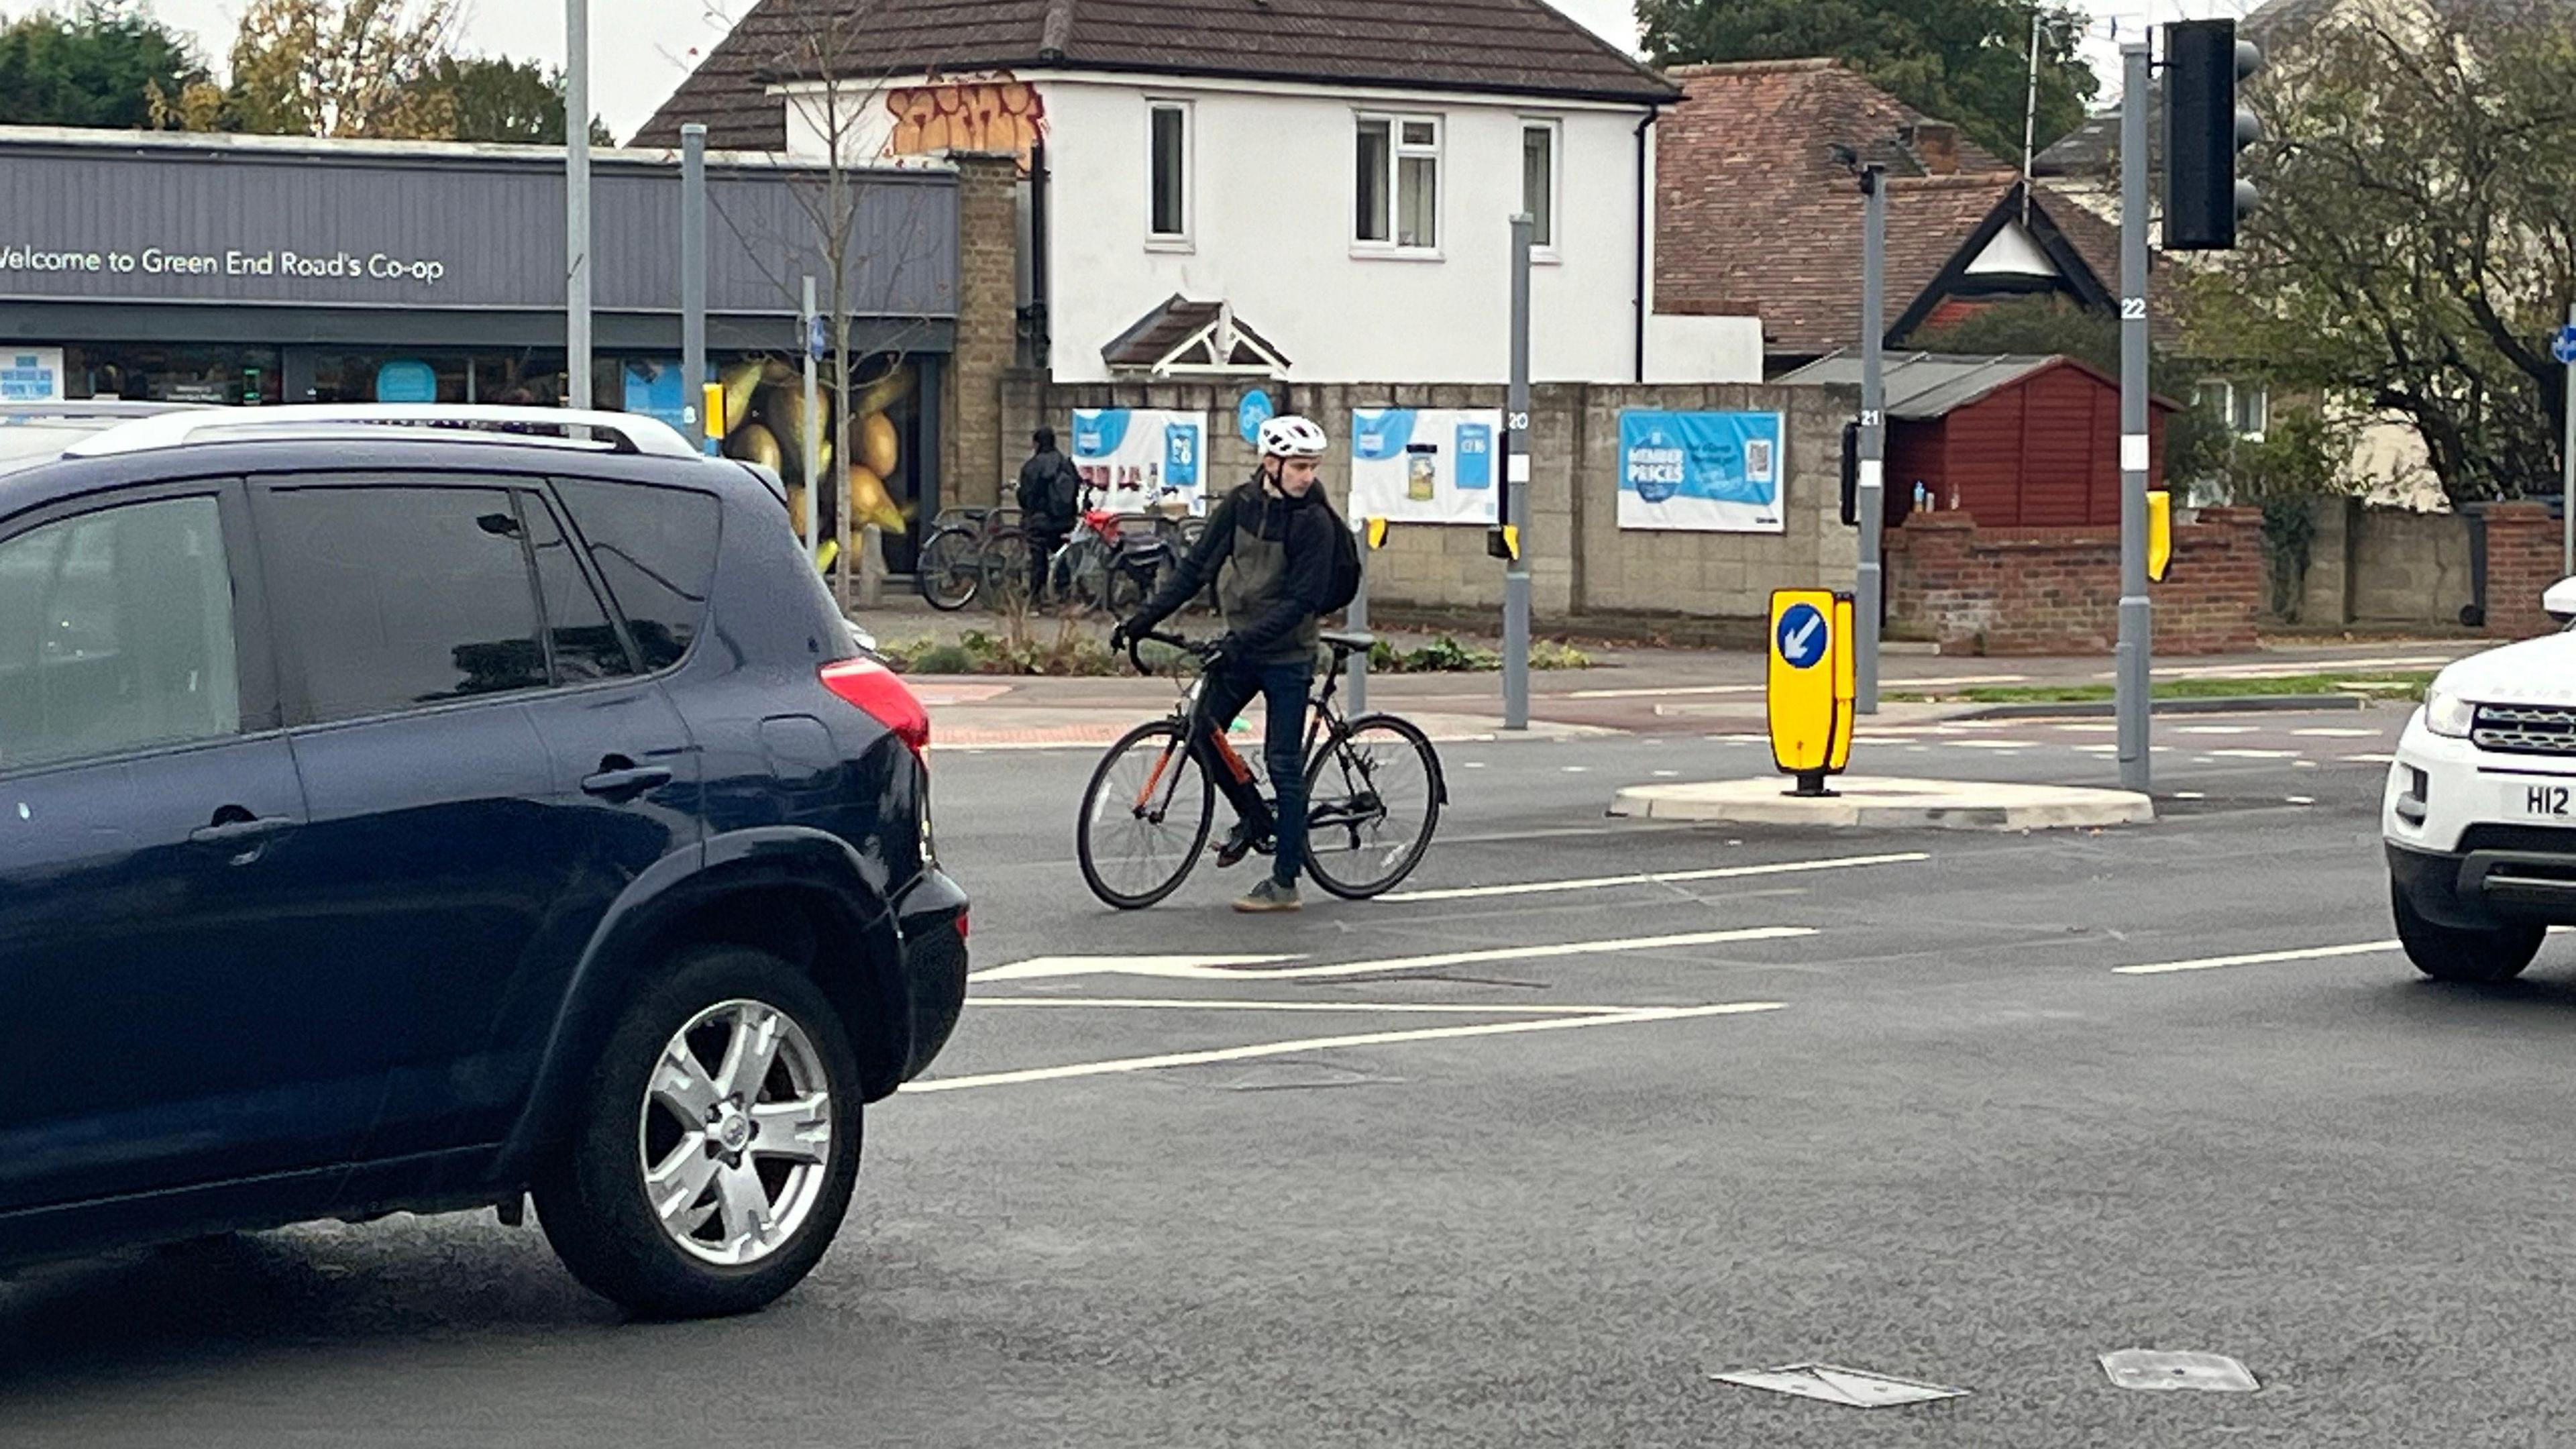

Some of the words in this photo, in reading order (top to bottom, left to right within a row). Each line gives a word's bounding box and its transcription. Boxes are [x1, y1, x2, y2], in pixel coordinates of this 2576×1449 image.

[108, 251, 135, 272] to
[142, 247, 218, 274] Green
[226, 250, 272, 274] End
[281, 251, 362, 276] Road's
[368, 253, 444, 285] Co-op
[2121, 297, 2146, 319] 22
[1509, 412, 1528, 429] 20
[1862, 410, 1878, 425] 21
[1627, 464, 1685, 484] PRICES
